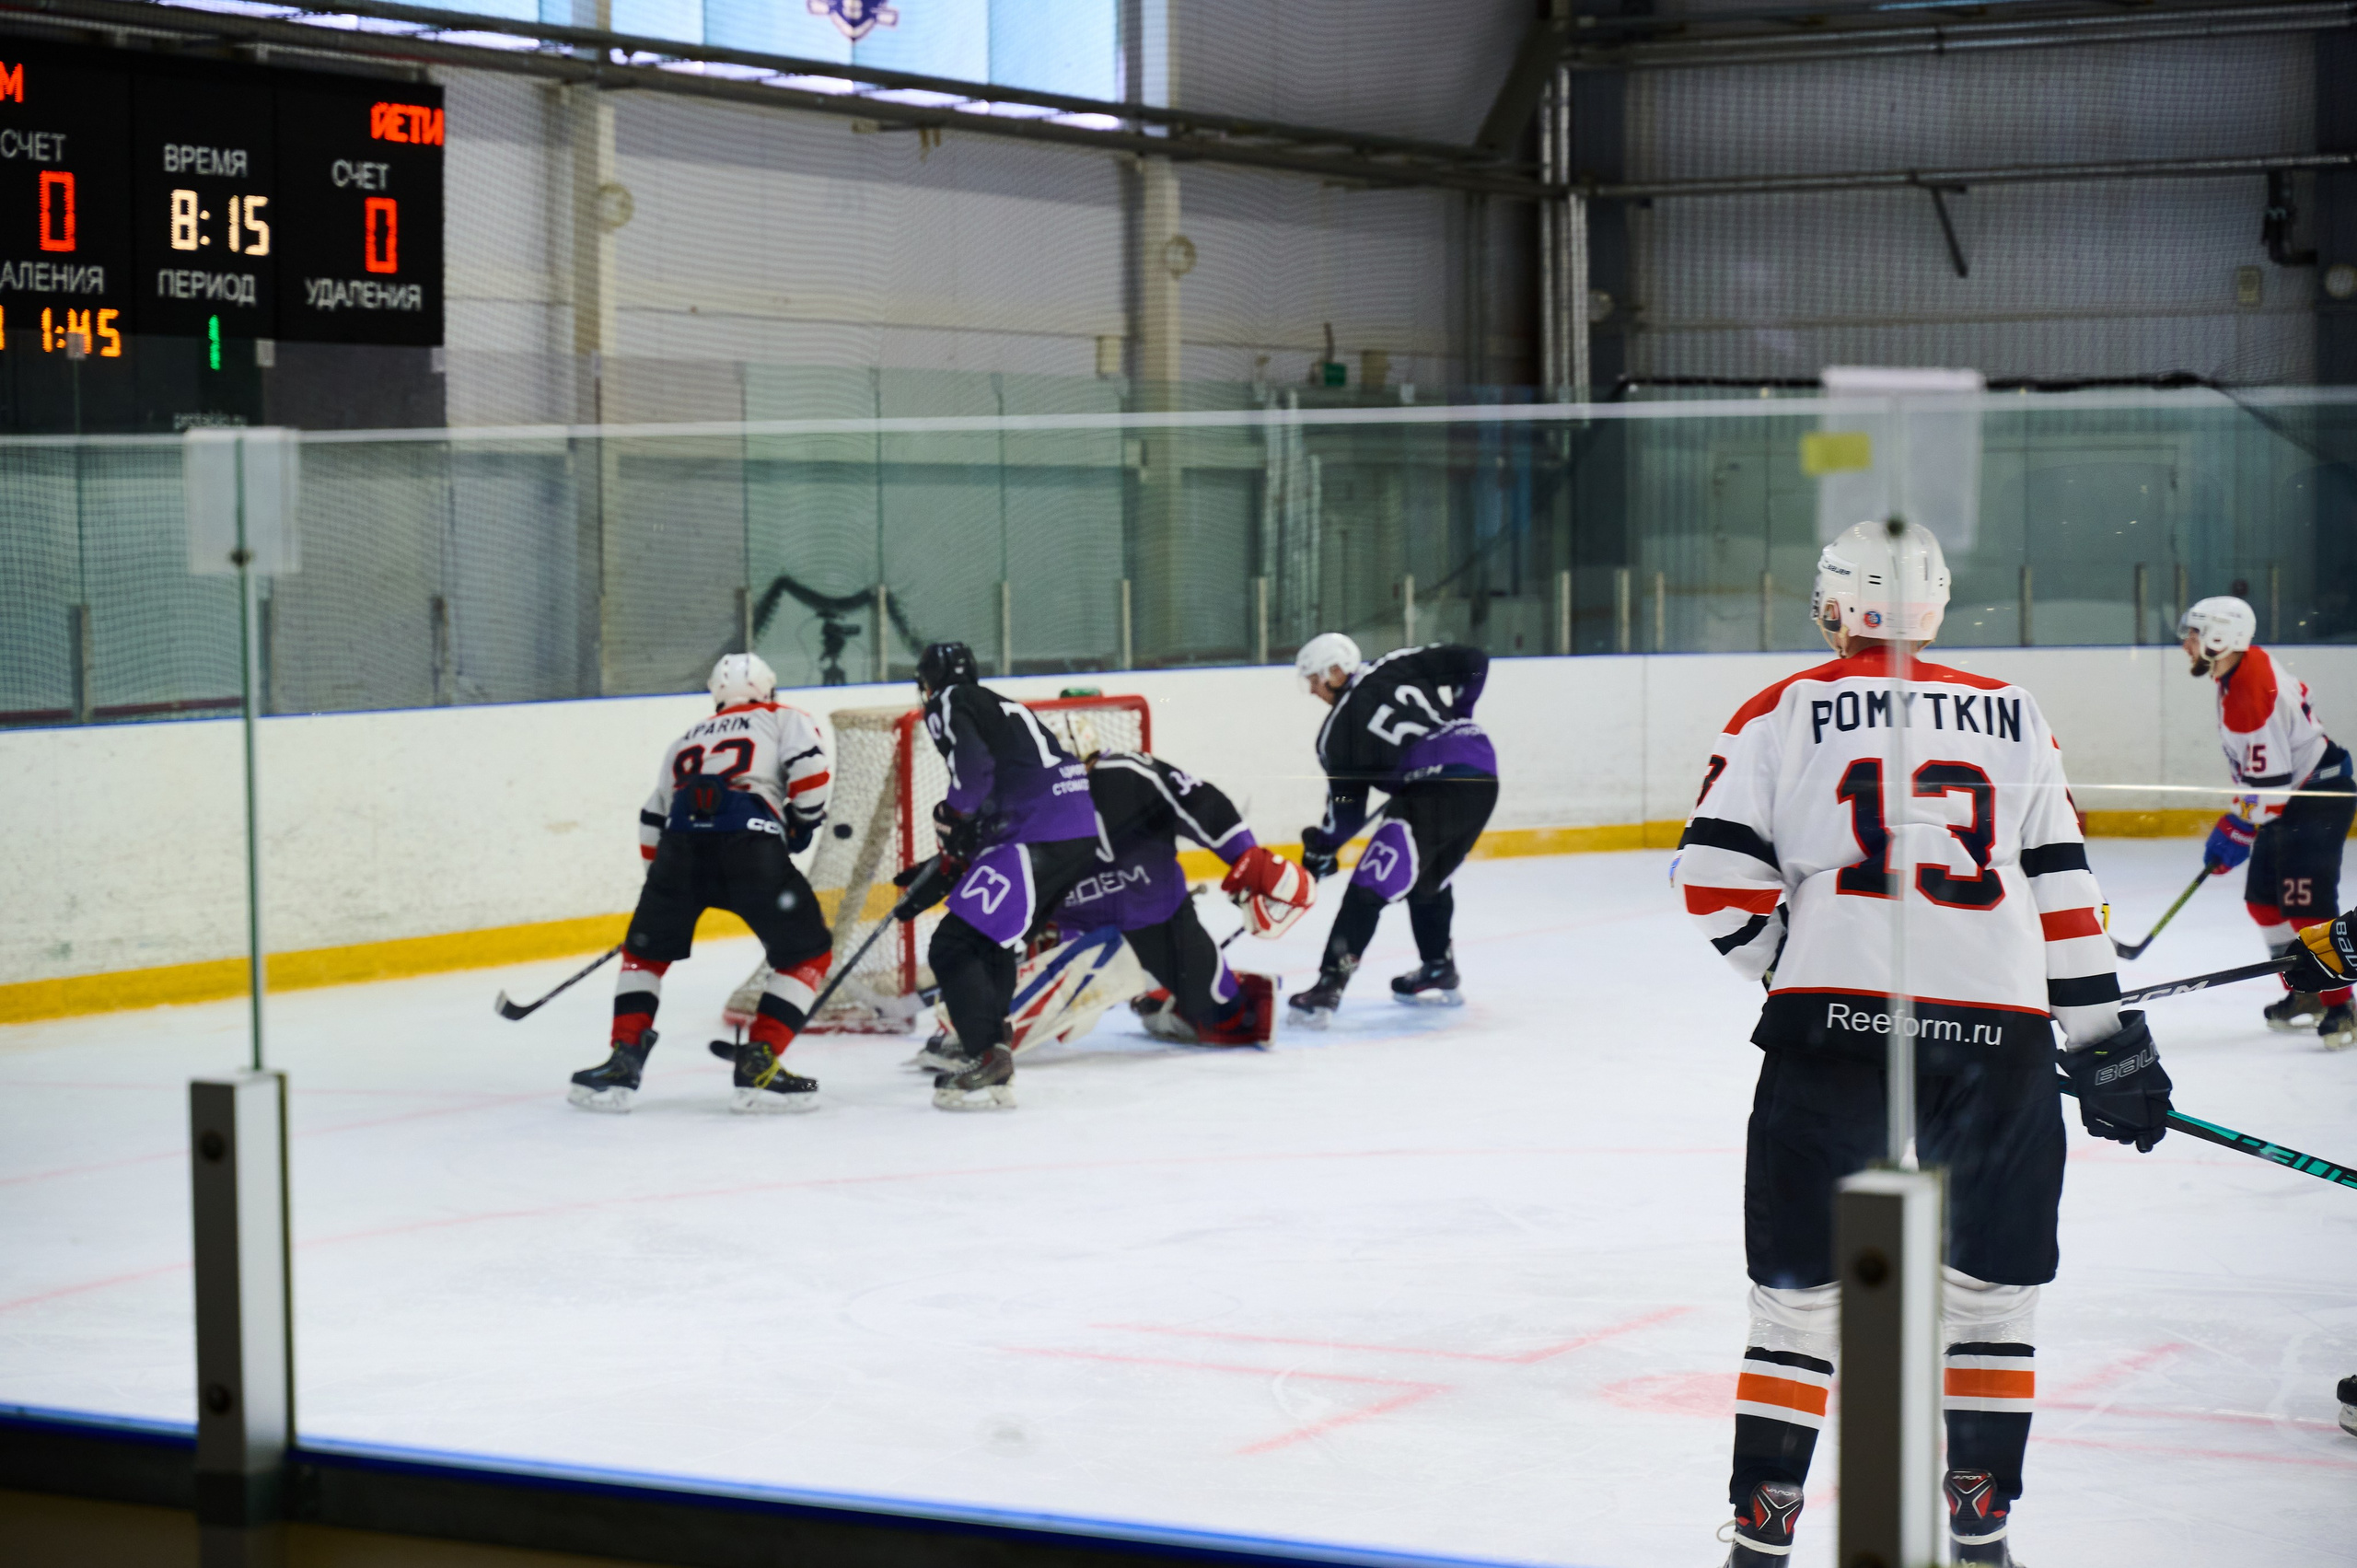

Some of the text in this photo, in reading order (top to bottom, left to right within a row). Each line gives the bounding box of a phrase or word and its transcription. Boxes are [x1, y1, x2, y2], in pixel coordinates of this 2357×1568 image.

[0, 129, 66, 161] СЧЕТ
[164, 143, 248, 178] ВРЕМЯ
[331, 159, 390, 191] СЧЕТ
[39, 170, 75, 251] 0
[170, 189, 270, 256] 8:15
[365, 197, 398, 273] 0
[157, 269, 257, 308] ПЕРИОД
[305, 277, 423, 311] УДАЛЕНИЯ
[41, 307, 122, 357] 1:45
[208, 314, 220, 370] 1
[1811, 690, 2021, 744] POMYTKIN
[1835, 757, 2006, 911] 13
[2283, 877, 2313, 906] 25
[1826, 1003, 2003, 1045] Reeform.ru
